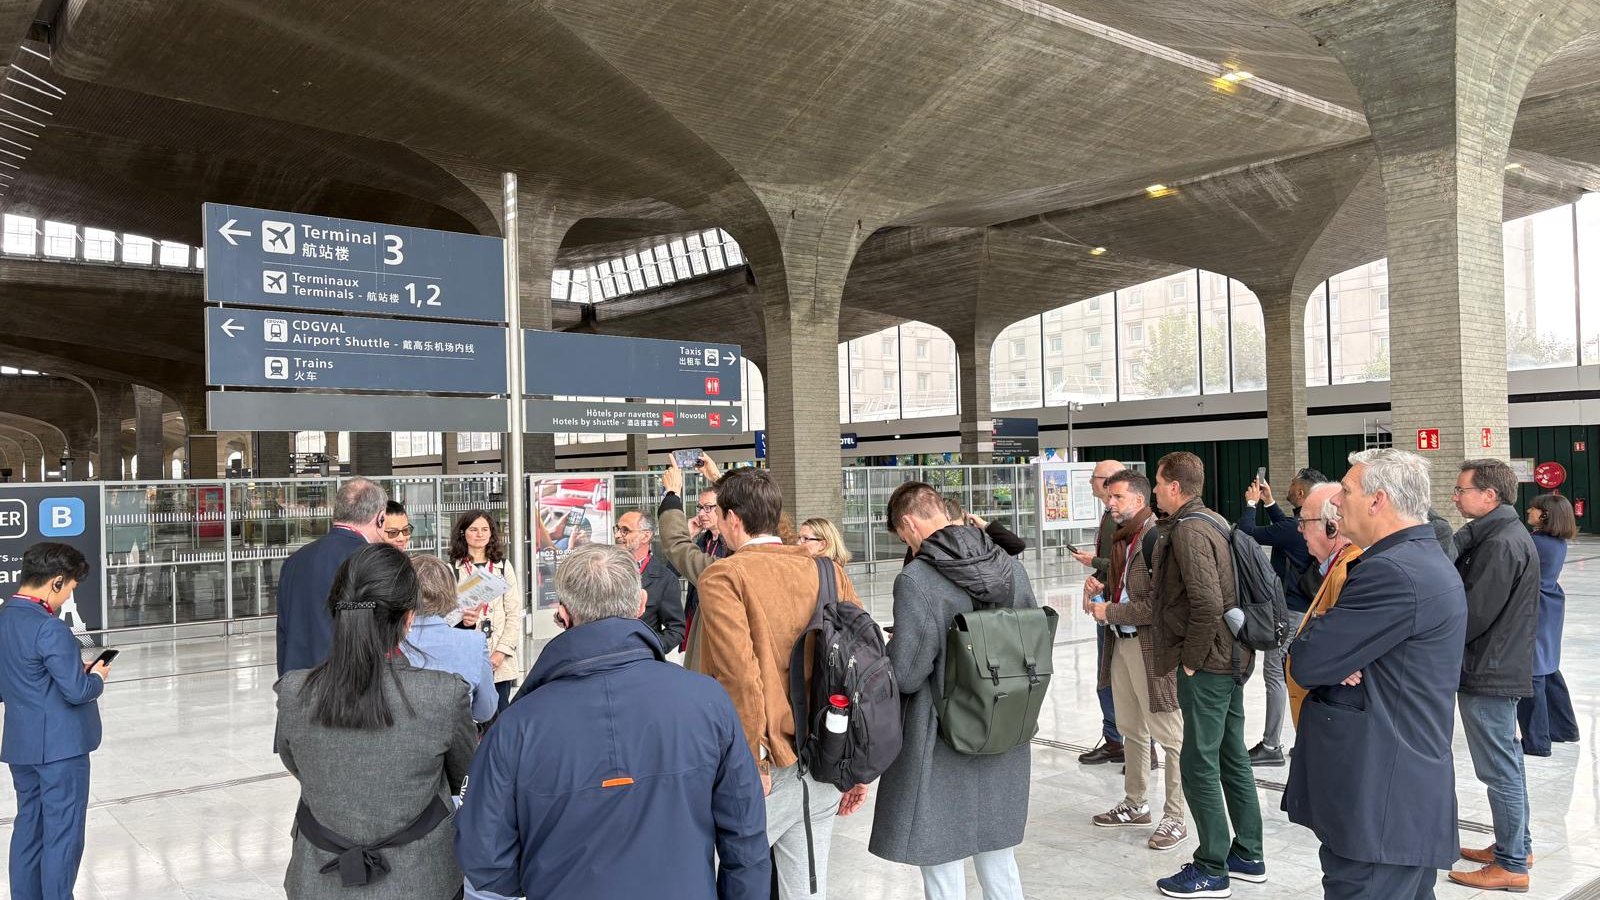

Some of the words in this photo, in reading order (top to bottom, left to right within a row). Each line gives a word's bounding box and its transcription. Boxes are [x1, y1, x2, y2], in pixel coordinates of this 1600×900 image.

[301, 224, 377, 246] Terminal
[383, 234, 404, 266] 3
[302, 242, 350, 262] 航站楼
[292, 272, 359, 288] Terminaux
[292, 285, 354, 300] Terminals
[366, 291, 400, 304] 航站楼
[292, 320, 346, 334] CDGVAL
[292, 333, 341, 348] Airport
[345, 336, 390, 349] Shuttle
[402, 339, 475, 354] 戴高乐机场内线
[679, 346, 702, 356] Taxis
[294, 357, 334, 369] Trains
[679, 357, 702, 366] 出租车
[294, 370, 318, 382] 火车
[586, 408, 612, 418] Hôtels
[613, 411, 627, 419] par
[628, 411, 660, 419] navettes
[679, 411, 707, 419] Novotel
[552, 417, 579, 426] Hotels
[580, 417, 590, 427] by
[592, 418, 620, 426] shuttle
[0, 511, 21, 527] ER
[52, 506, 73, 528] B
